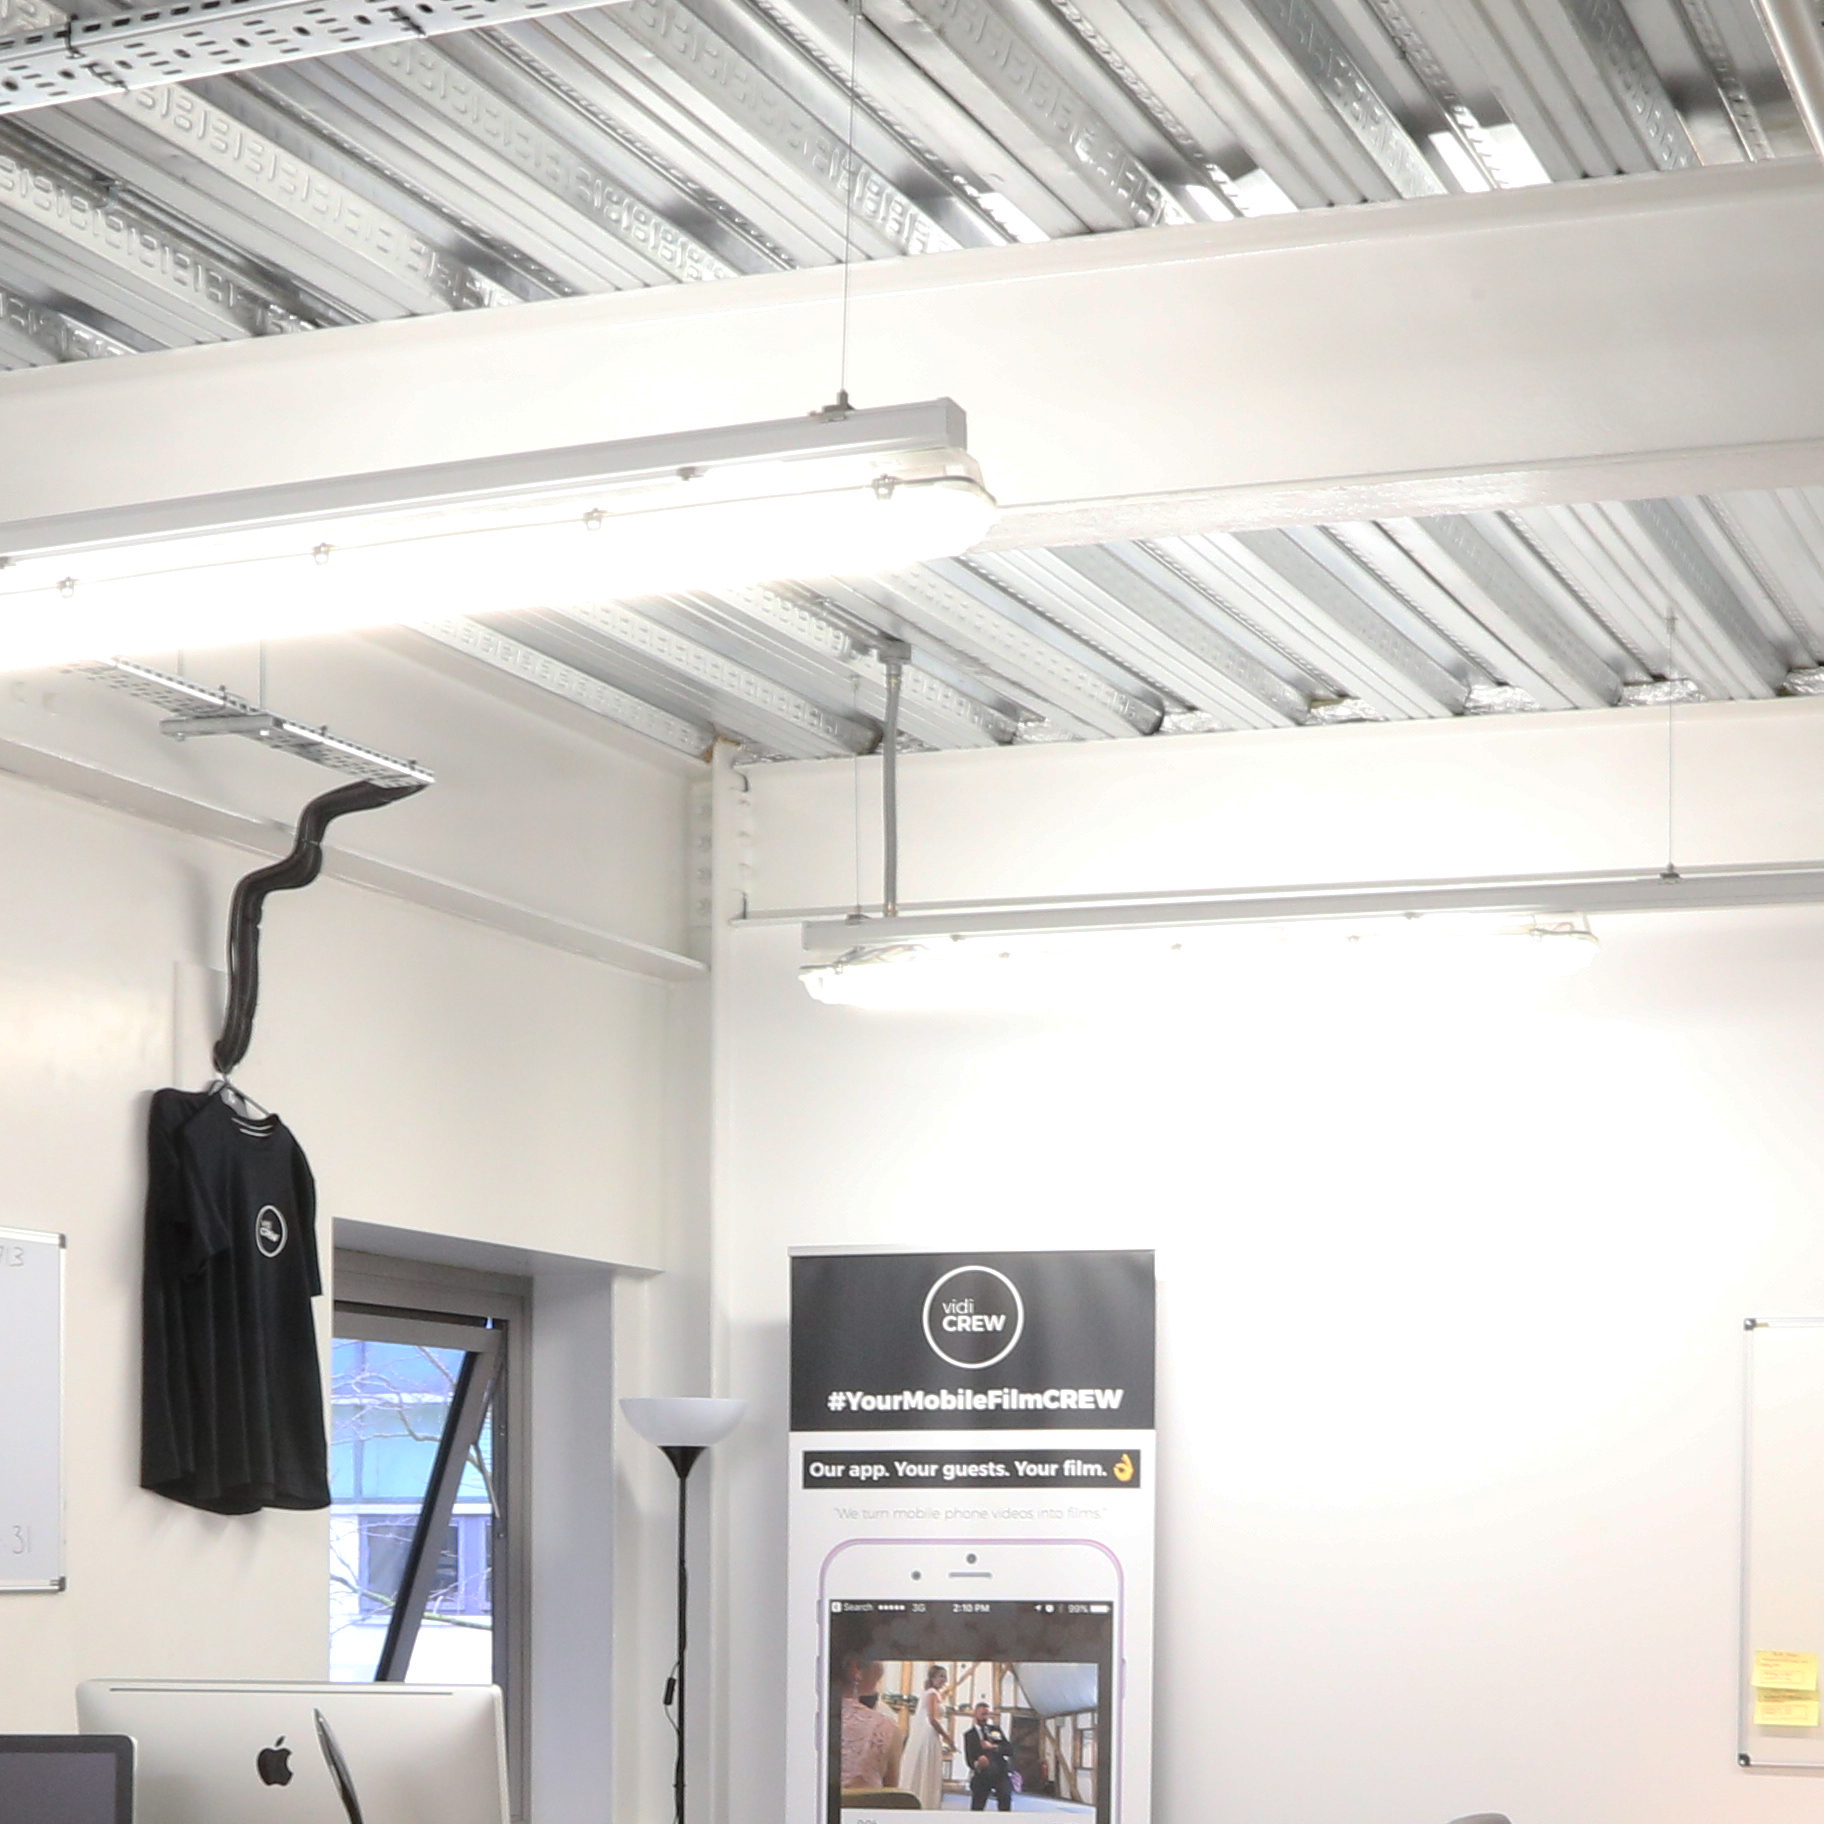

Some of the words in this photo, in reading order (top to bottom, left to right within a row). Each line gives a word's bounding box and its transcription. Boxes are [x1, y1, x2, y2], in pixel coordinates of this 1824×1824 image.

[942, 1298, 975, 1314] vidi
[942, 1314, 1007, 1332] CREW
[827, 1388, 1124, 1412] #YourMobileFilmCREW
[808, 1461, 846, 1478] Our
[848, 1464, 890, 1481] app.
[894, 1461, 939, 1478] Your
[942, 1462, 1010, 1481] guests.
[1014, 1460, 1059, 1477] Your
[1062, 1459, 1108, 1477] film.
[861, 1507, 889, 1520] turn
[893, 1507, 941, 1520] mobile
[944, 1507, 989, 1522] phone
[991, 1507, 1034, 1520] videos
[1037, 1507, 1064, 1520] into
[12, 1525, 32, 1555] 31
[843, 1602, 874, 1612] Search
[911, 1603, 927, 1613] 3G
[974, 1603, 991, 1613] PM
